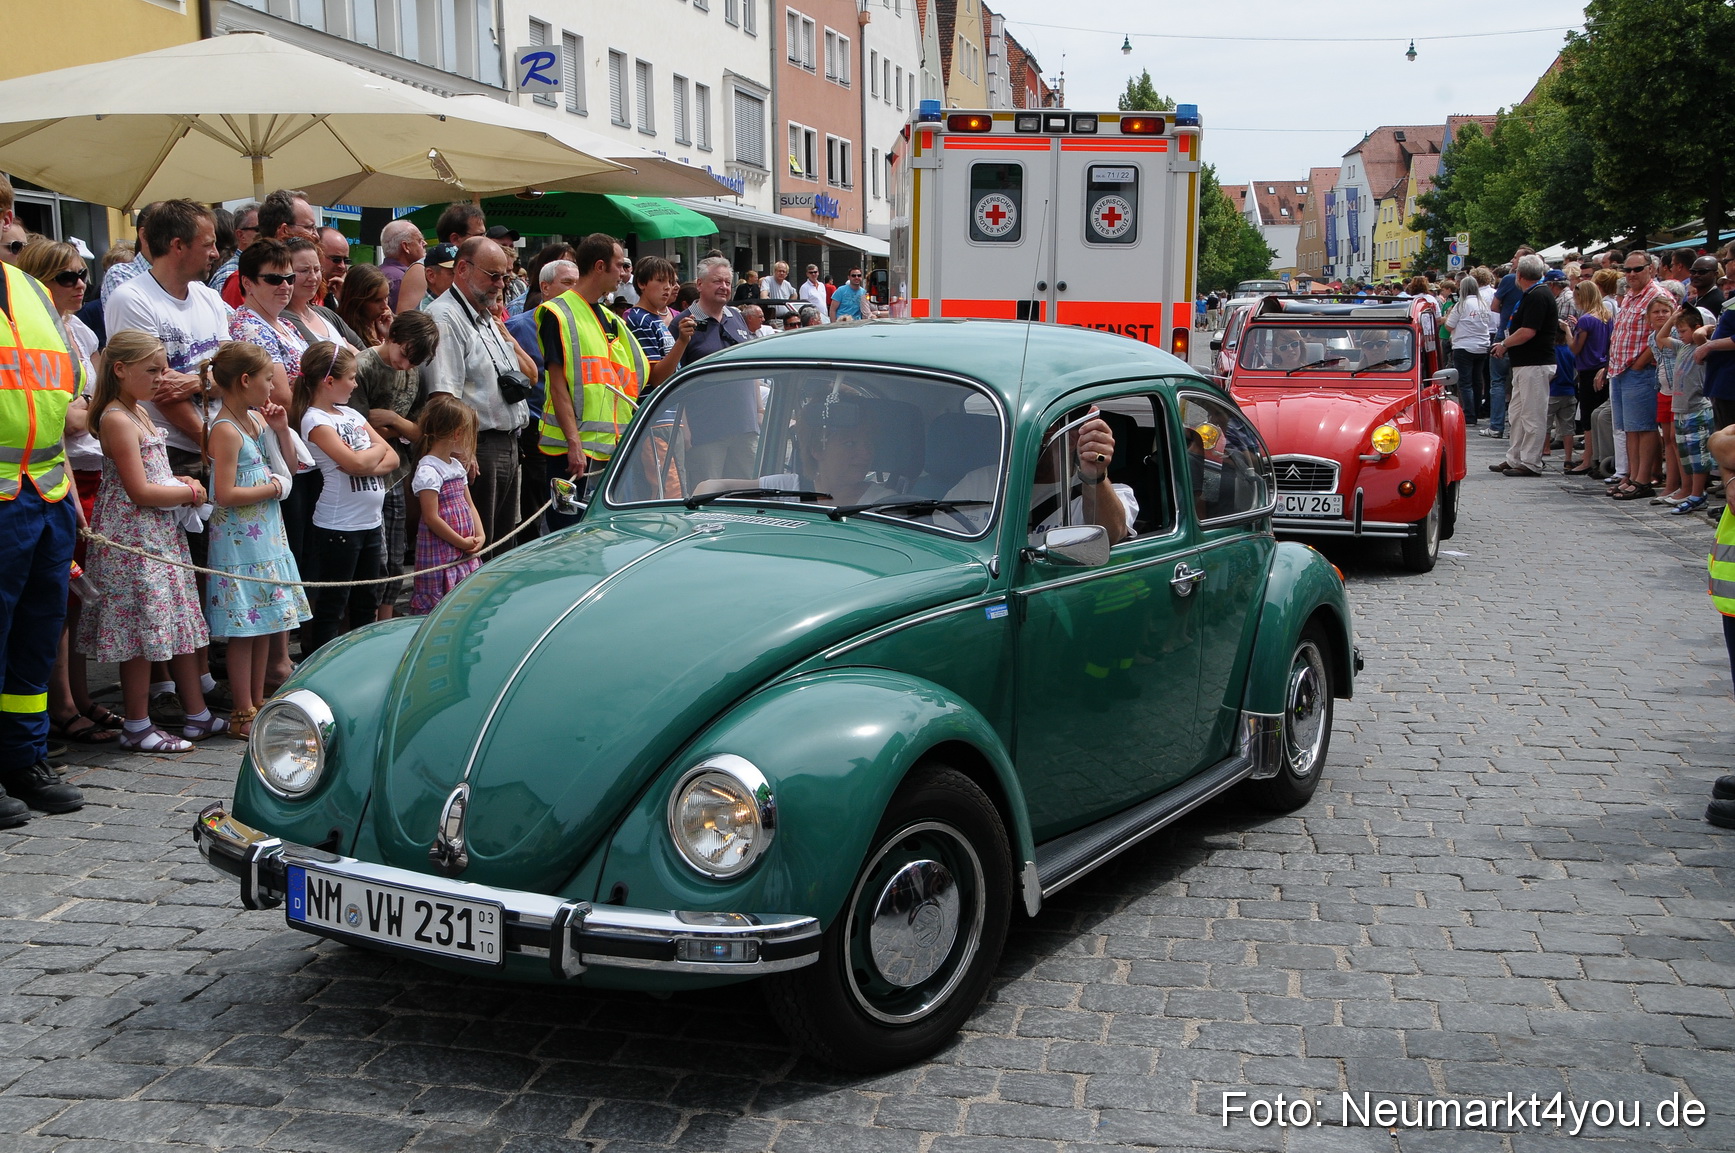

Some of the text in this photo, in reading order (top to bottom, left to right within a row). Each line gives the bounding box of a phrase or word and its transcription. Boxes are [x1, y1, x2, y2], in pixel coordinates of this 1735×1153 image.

[484, 209, 567, 218] mmsbräu
[978, 196, 1014, 214] BAYERISCHES
[1094, 198, 1130, 216] BAYERISCHES
[978, 215, 1014, 233] ROTES KREUZ
[1093, 217, 1130, 235] ROTES KREUZ
[1071, 323, 1154, 343] NST
[1286, 496, 1331, 512] CV 26
[294, 898, 301, 909] D
[306, 875, 476, 952] NM VW 231
[478, 910, 494, 924] 03
[479, 940, 494, 954] 10
